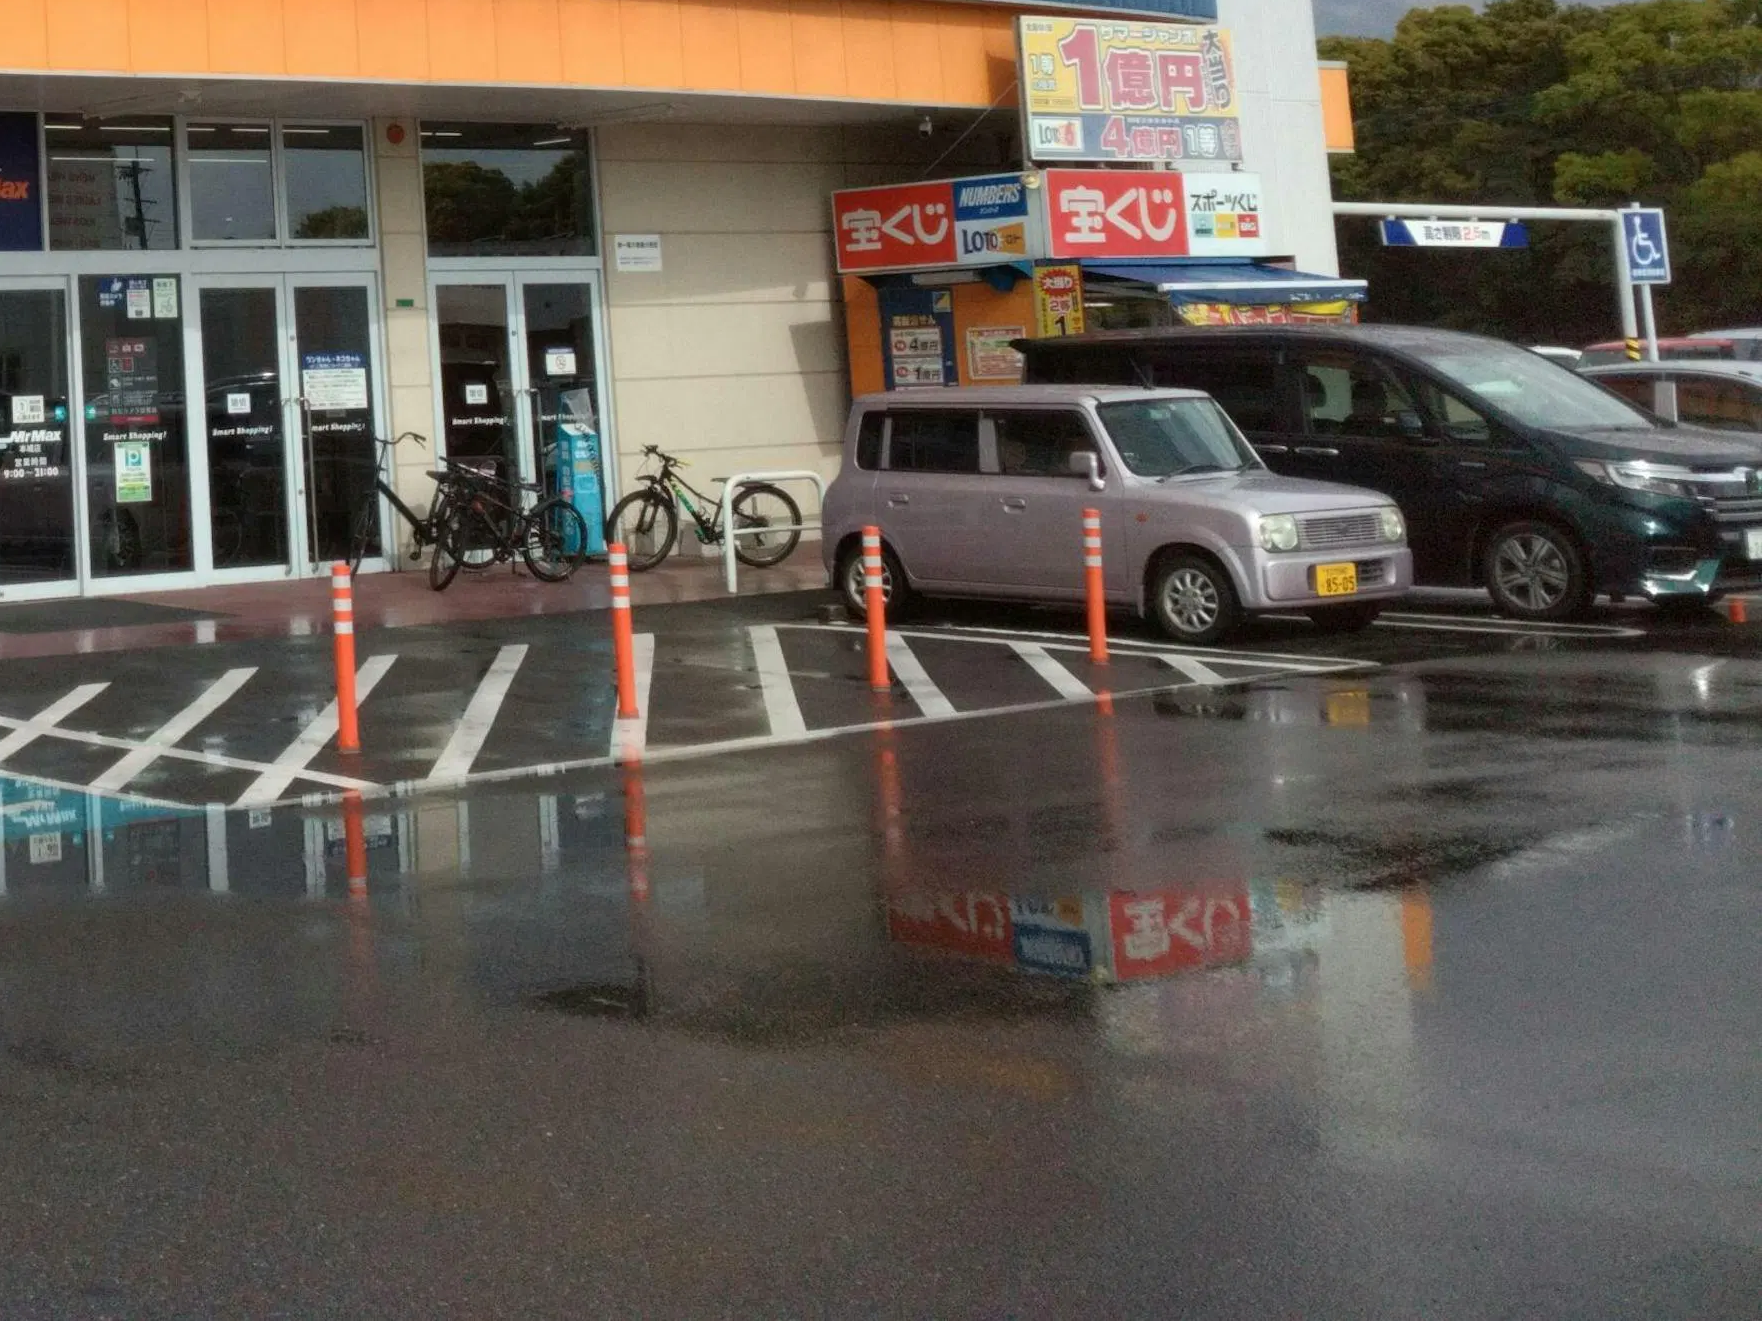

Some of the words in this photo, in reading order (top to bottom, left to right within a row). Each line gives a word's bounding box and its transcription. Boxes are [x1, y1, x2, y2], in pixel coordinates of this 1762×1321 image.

[1059, 24, 1207, 112] 1億円
[1101, 115, 1183, 159] 4億円
[959, 182, 1021, 207] NUMBERS
[1190, 188, 1257, 212] スポーツくじ
[841, 203, 949, 252] 宝くじ
[1059, 185, 1177, 245] 宝くじ
[962, 229, 998, 255] LOTO
[103, 433, 127, 441] Smart
[129, 431, 167, 441] Shopping!
[212, 428, 234, 436] Smart
[237, 425, 273, 435] Shopping!
